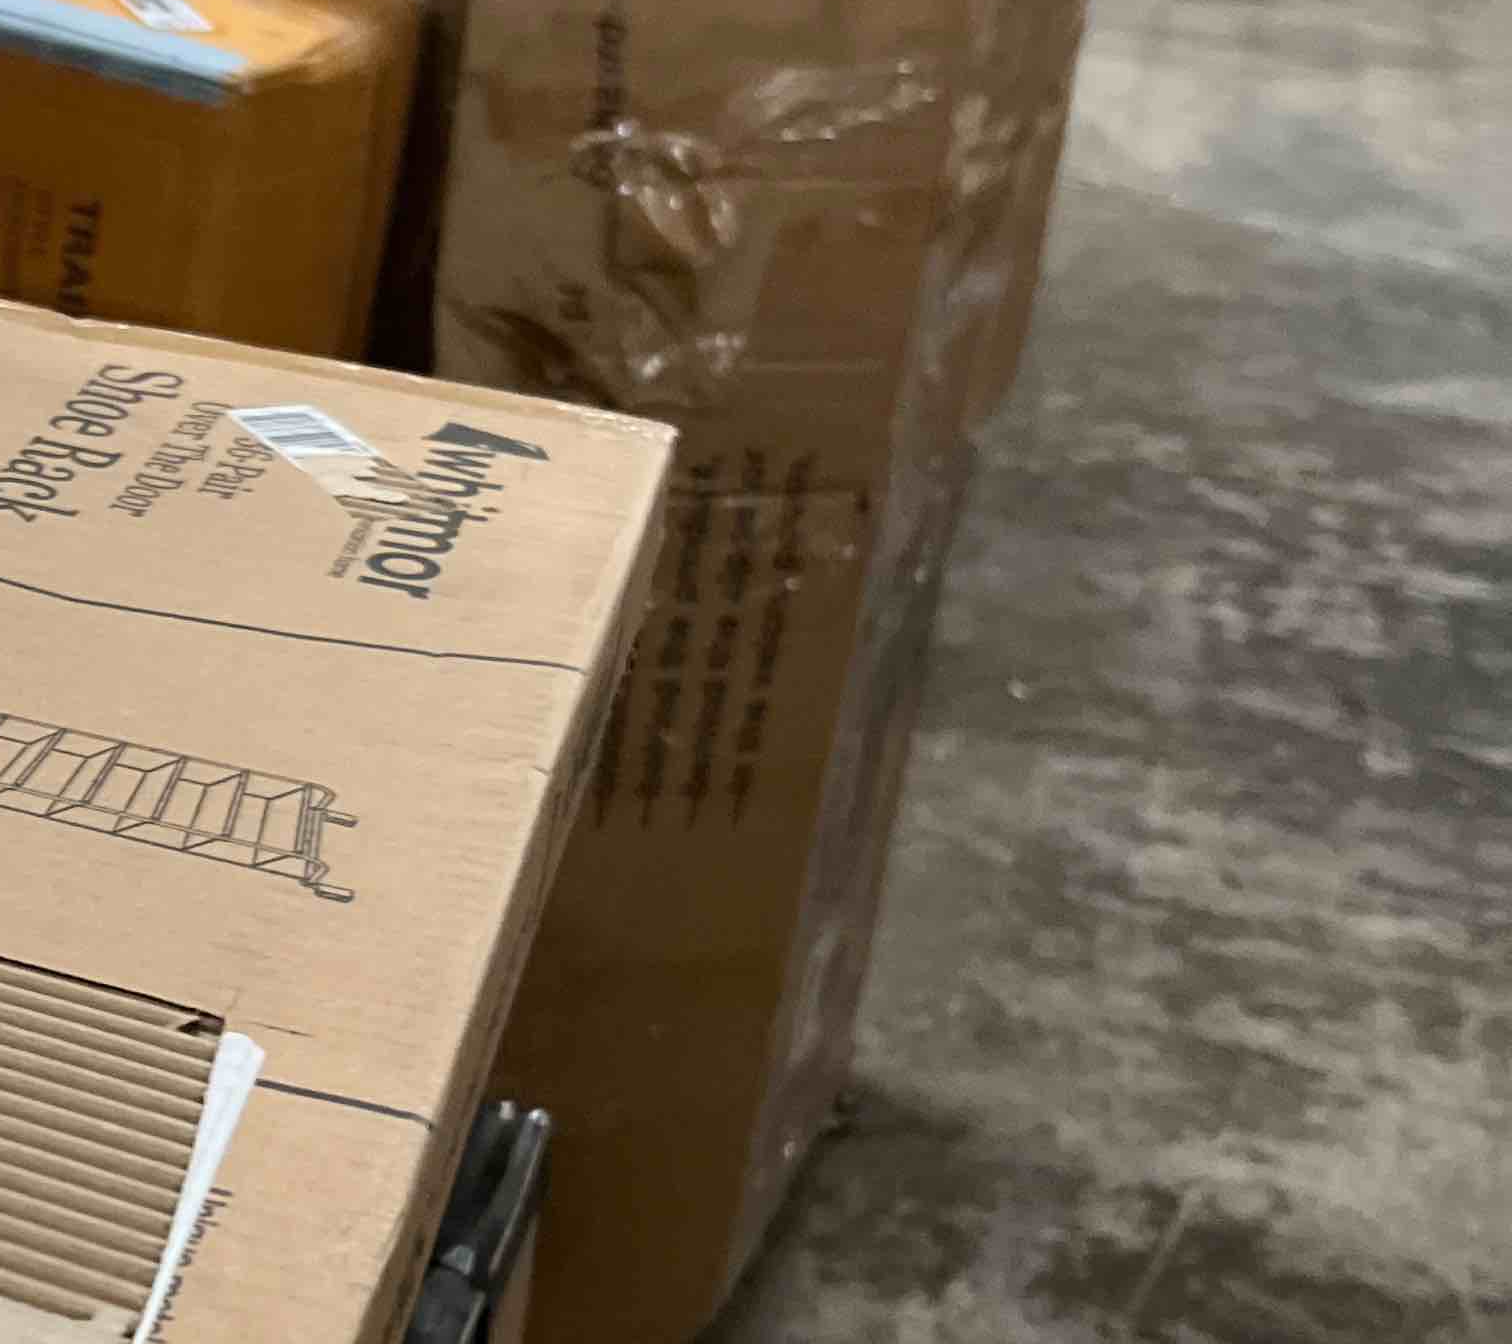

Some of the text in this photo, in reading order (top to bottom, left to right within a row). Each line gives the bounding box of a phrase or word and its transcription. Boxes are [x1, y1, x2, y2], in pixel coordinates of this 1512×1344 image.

[48, 364, 185, 438] Shoe
[106, 400, 234, 518] Over The Door
